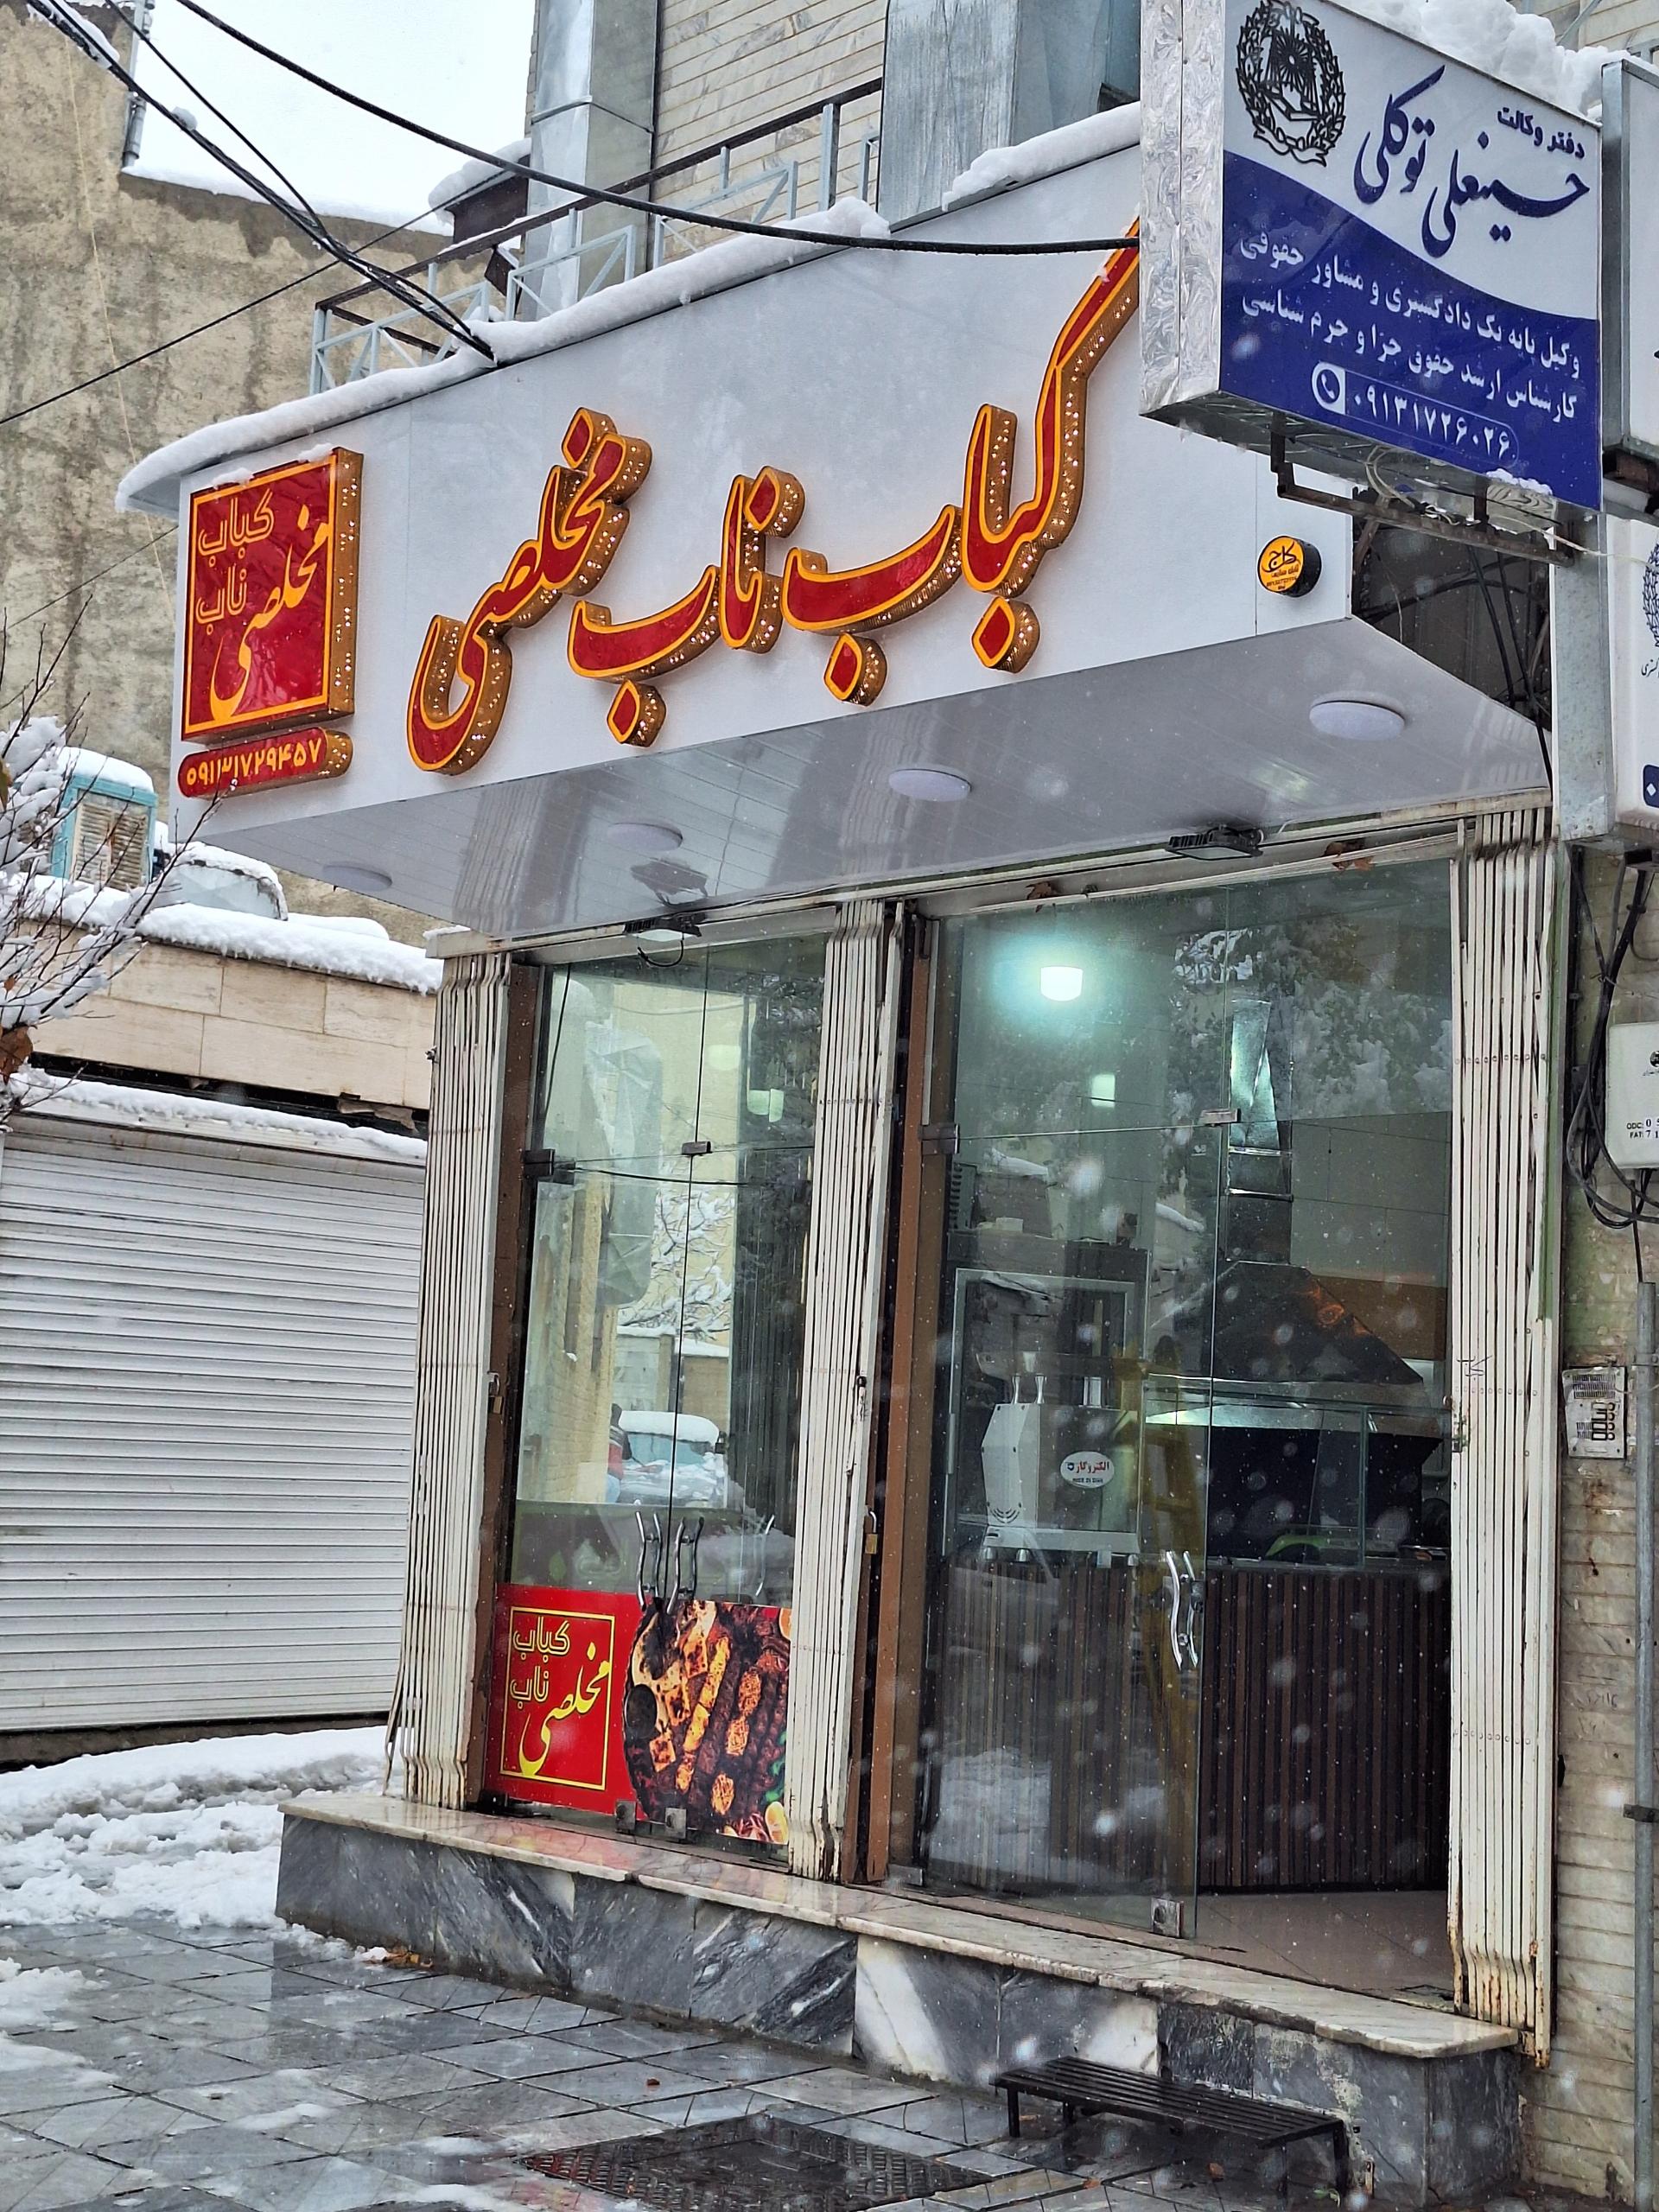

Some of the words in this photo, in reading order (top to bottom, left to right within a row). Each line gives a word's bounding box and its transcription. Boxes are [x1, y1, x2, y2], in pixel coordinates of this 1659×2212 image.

[1353, 65, 1446, 204] توکلی
[1497, 107, 1543, 147] وکالت
[1547, 132, 1585, 159] دفتر
[1240, 231, 1304, 270] حقوقی
[1311, 254, 1364, 291] مشاور
[1370, 281, 1380, 306] و
[1385, 287, 1471, 330] دادگستری
[1355, 330, 1365, 355] و
[1477, 314, 1503, 349] یک
[1408, 349, 1455, 378] حقوق
[1541, 336, 1580, 379] وکیل
[1354, 385, 1510, 461] ۰۹۱۳۱۷۲۶۰۲۶
[781, 217, 1140, 707] کباب
[198, 488, 274, 567] کباب
[195, 563, 248, 635] ناب
[210, 504, 330, 721] مخلصی
[407, 407, 652, 776] مخلصی
[567, 465, 805, 747] ناب
[186, 737, 322, 785] ۰۹۱۳۱۷۲۹۴۵۷
[513, 1616, 570, 1663] کباب
[510, 1665, 550, 1710] ناب
[518, 1642, 611, 1777] مخلصی
